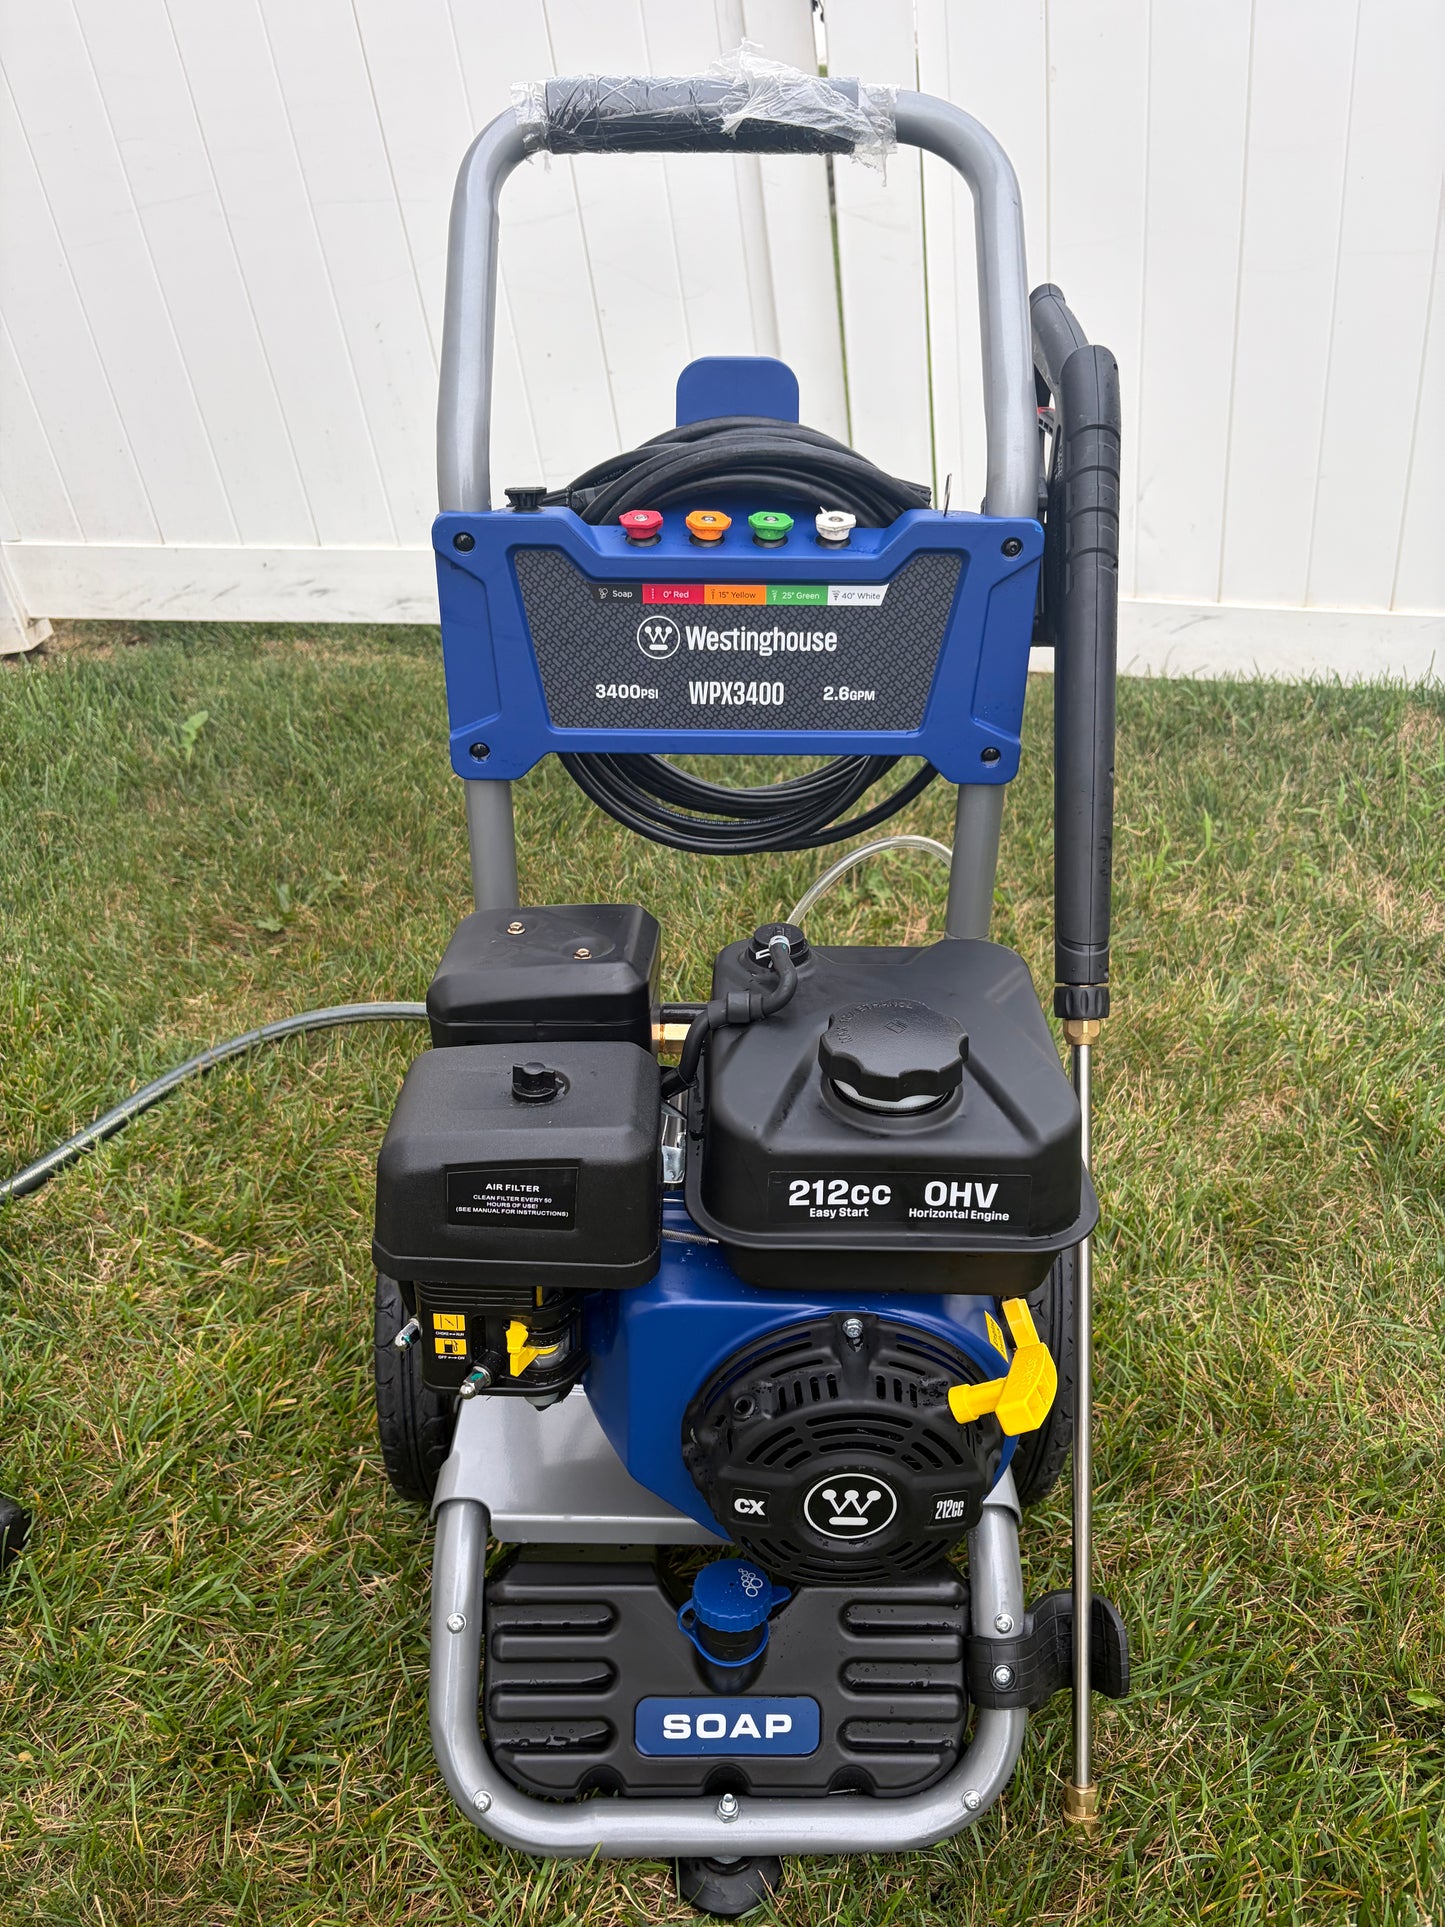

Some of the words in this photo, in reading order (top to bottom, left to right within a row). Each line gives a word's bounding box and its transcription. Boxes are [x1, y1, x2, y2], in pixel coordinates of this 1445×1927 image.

[612, 590, 633, 600] Soap
[663, 590, 672, 599] 0°
[673, 590, 689, 599] Red
[718, 591, 729, 599] 15°
[730, 590, 757, 600] Yellow
[782, 591, 794, 600] 25°
[796, 591, 820, 600] Green
[841, 592, 854, 600] 40°
[855, 591, 881, 601] White
[685, 625, 838, 656] Westinghouse
[595, 684, 659, 699] 3400PSI
[689, 681, 785, 705] WPX3400
[823, 686, 875, 701] 2.6GPM
[485, 1183, 503, 1191] AIR
[505, 1184, 540, 1192] FILTER
[788, 1179, 892, 1206] 212cc
[924, 1181, 999, 1209] OHV
[516, 1209, 568, 1217] INSTRUCTIONS)
[809, 1207, 837, 1219] Easy
[838, 1206, 869, 1218] Start
[908, 1207, 968, 1220] Horizontal
[970, 1211, 1010, 1222] Engine
[733, 1498, 766, 1516] CX
[934, 1499, 965, 1520] 212CC
[662, 1713, 792, 1740] SOAP
